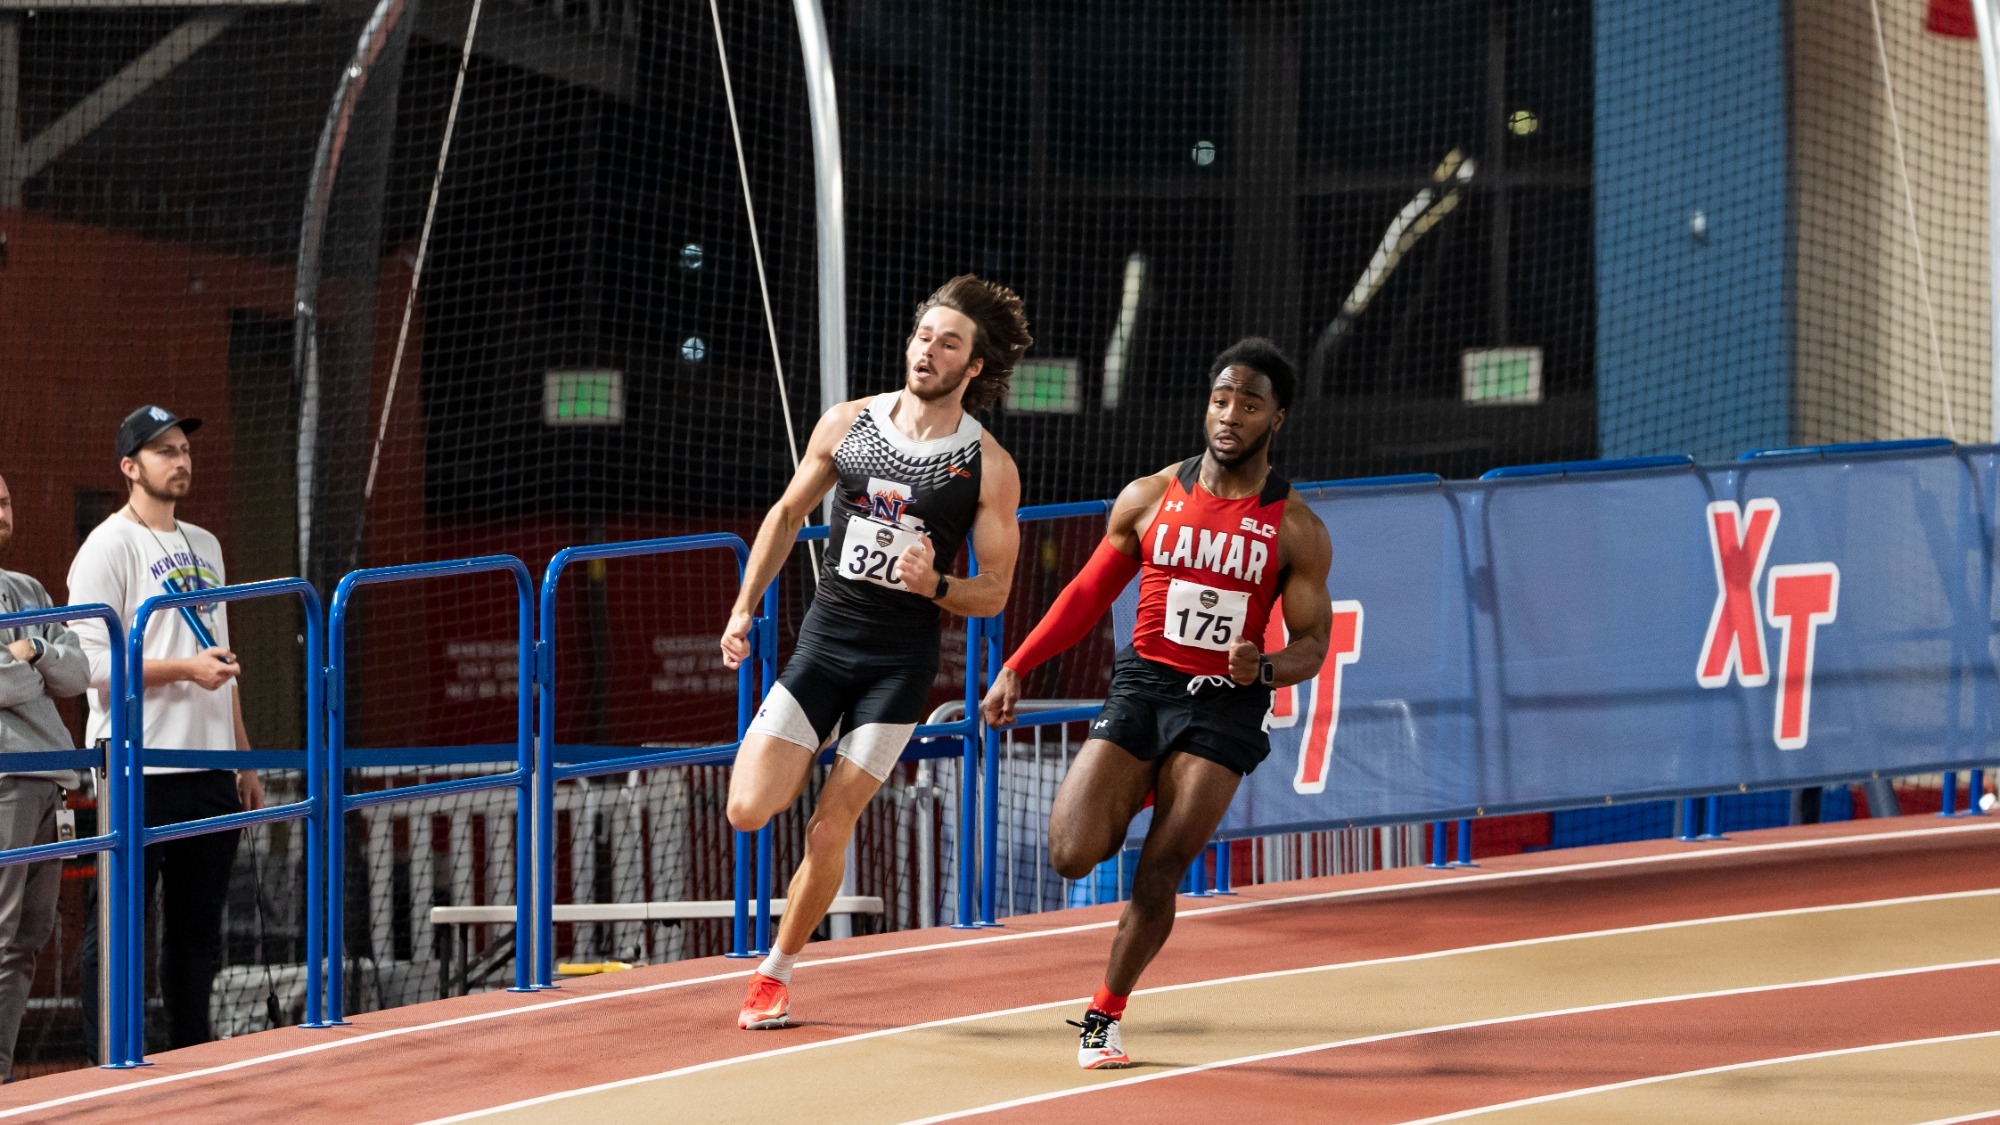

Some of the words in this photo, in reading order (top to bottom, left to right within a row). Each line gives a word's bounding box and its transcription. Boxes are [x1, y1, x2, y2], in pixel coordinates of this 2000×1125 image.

[1240, 517, 1277, 539] SLC
[150, 556, 176, 580] NEW
[1152, 523, 1269, 585] LAMAR
[1176, 608, 1234, 645] 175
[1696, 497, 1840, 750] XT
